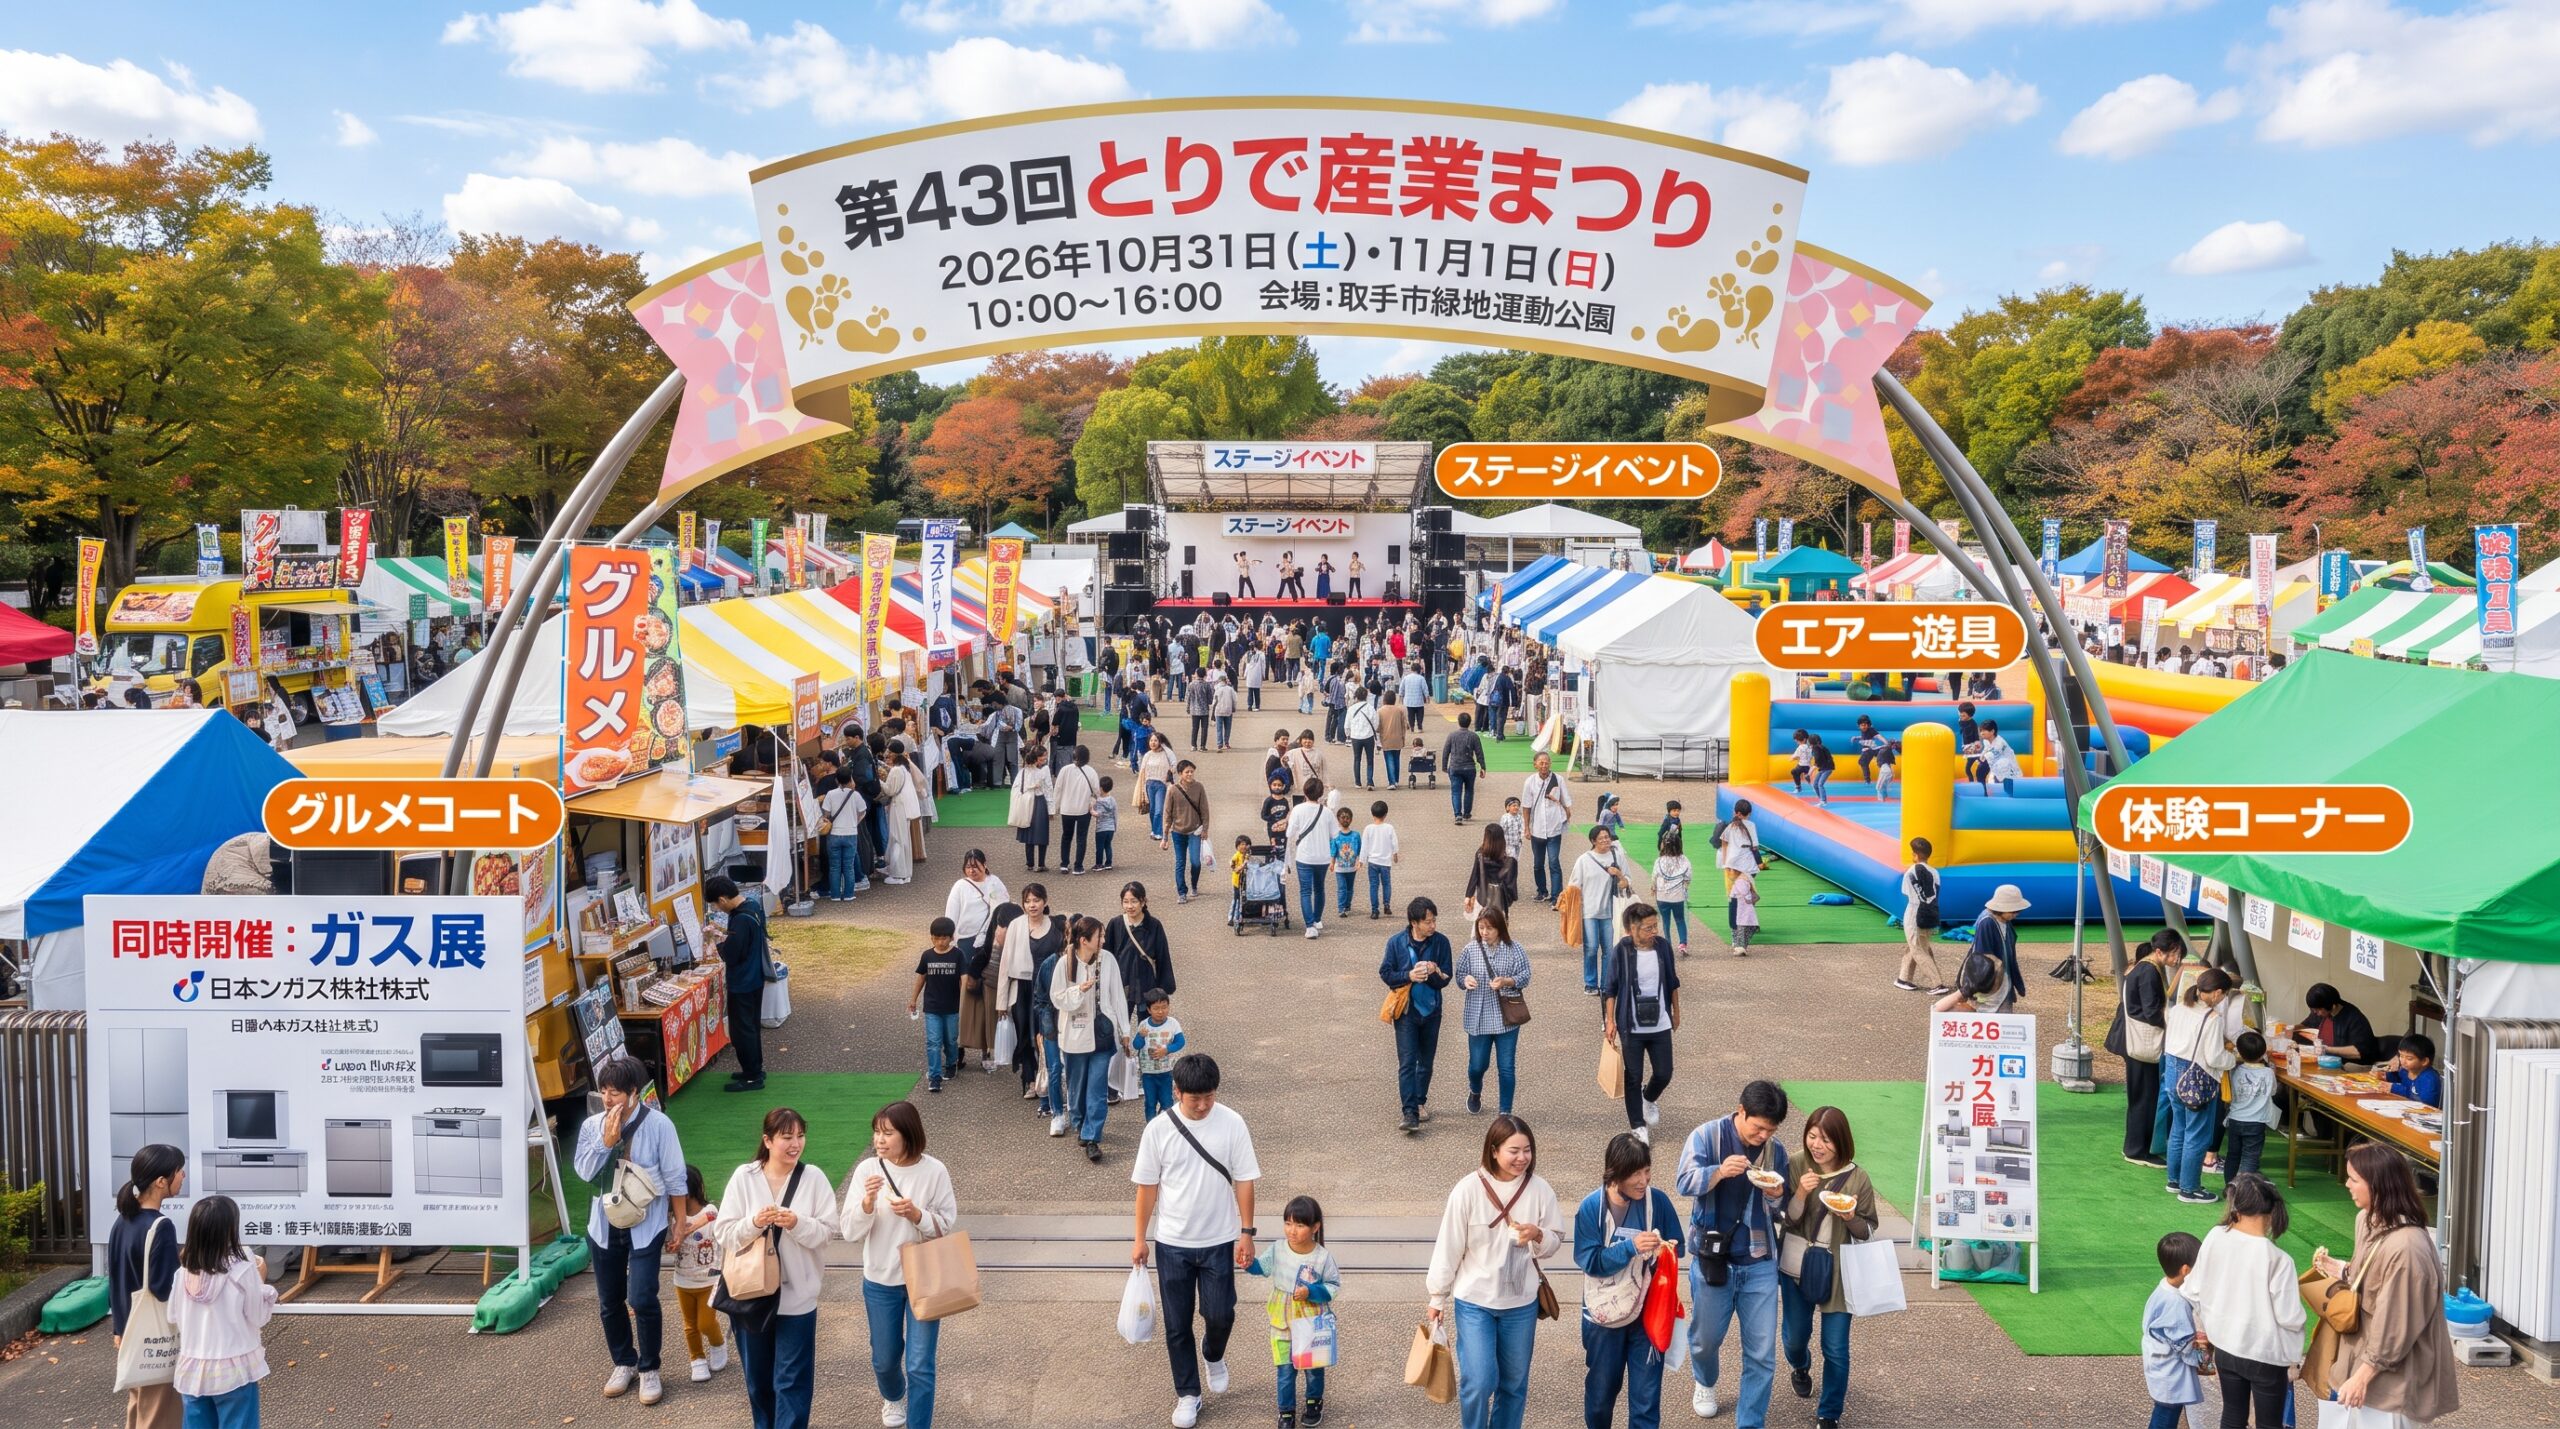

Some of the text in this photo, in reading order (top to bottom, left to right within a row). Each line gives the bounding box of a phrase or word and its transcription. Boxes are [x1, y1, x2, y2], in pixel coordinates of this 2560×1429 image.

[834, 132, 1712, 251] 第43回とりで産業まつり
[1259, 279, 1616, 335] 会場：取手市緑地運動公園
[1214, 448, 1365, 469] ステージイベント
[1229, 517, 1350, 534] ステージイベント
[576, 562, 640, 743] グルメ
[112, 912, 487, 969] 同時開催：ガス展
